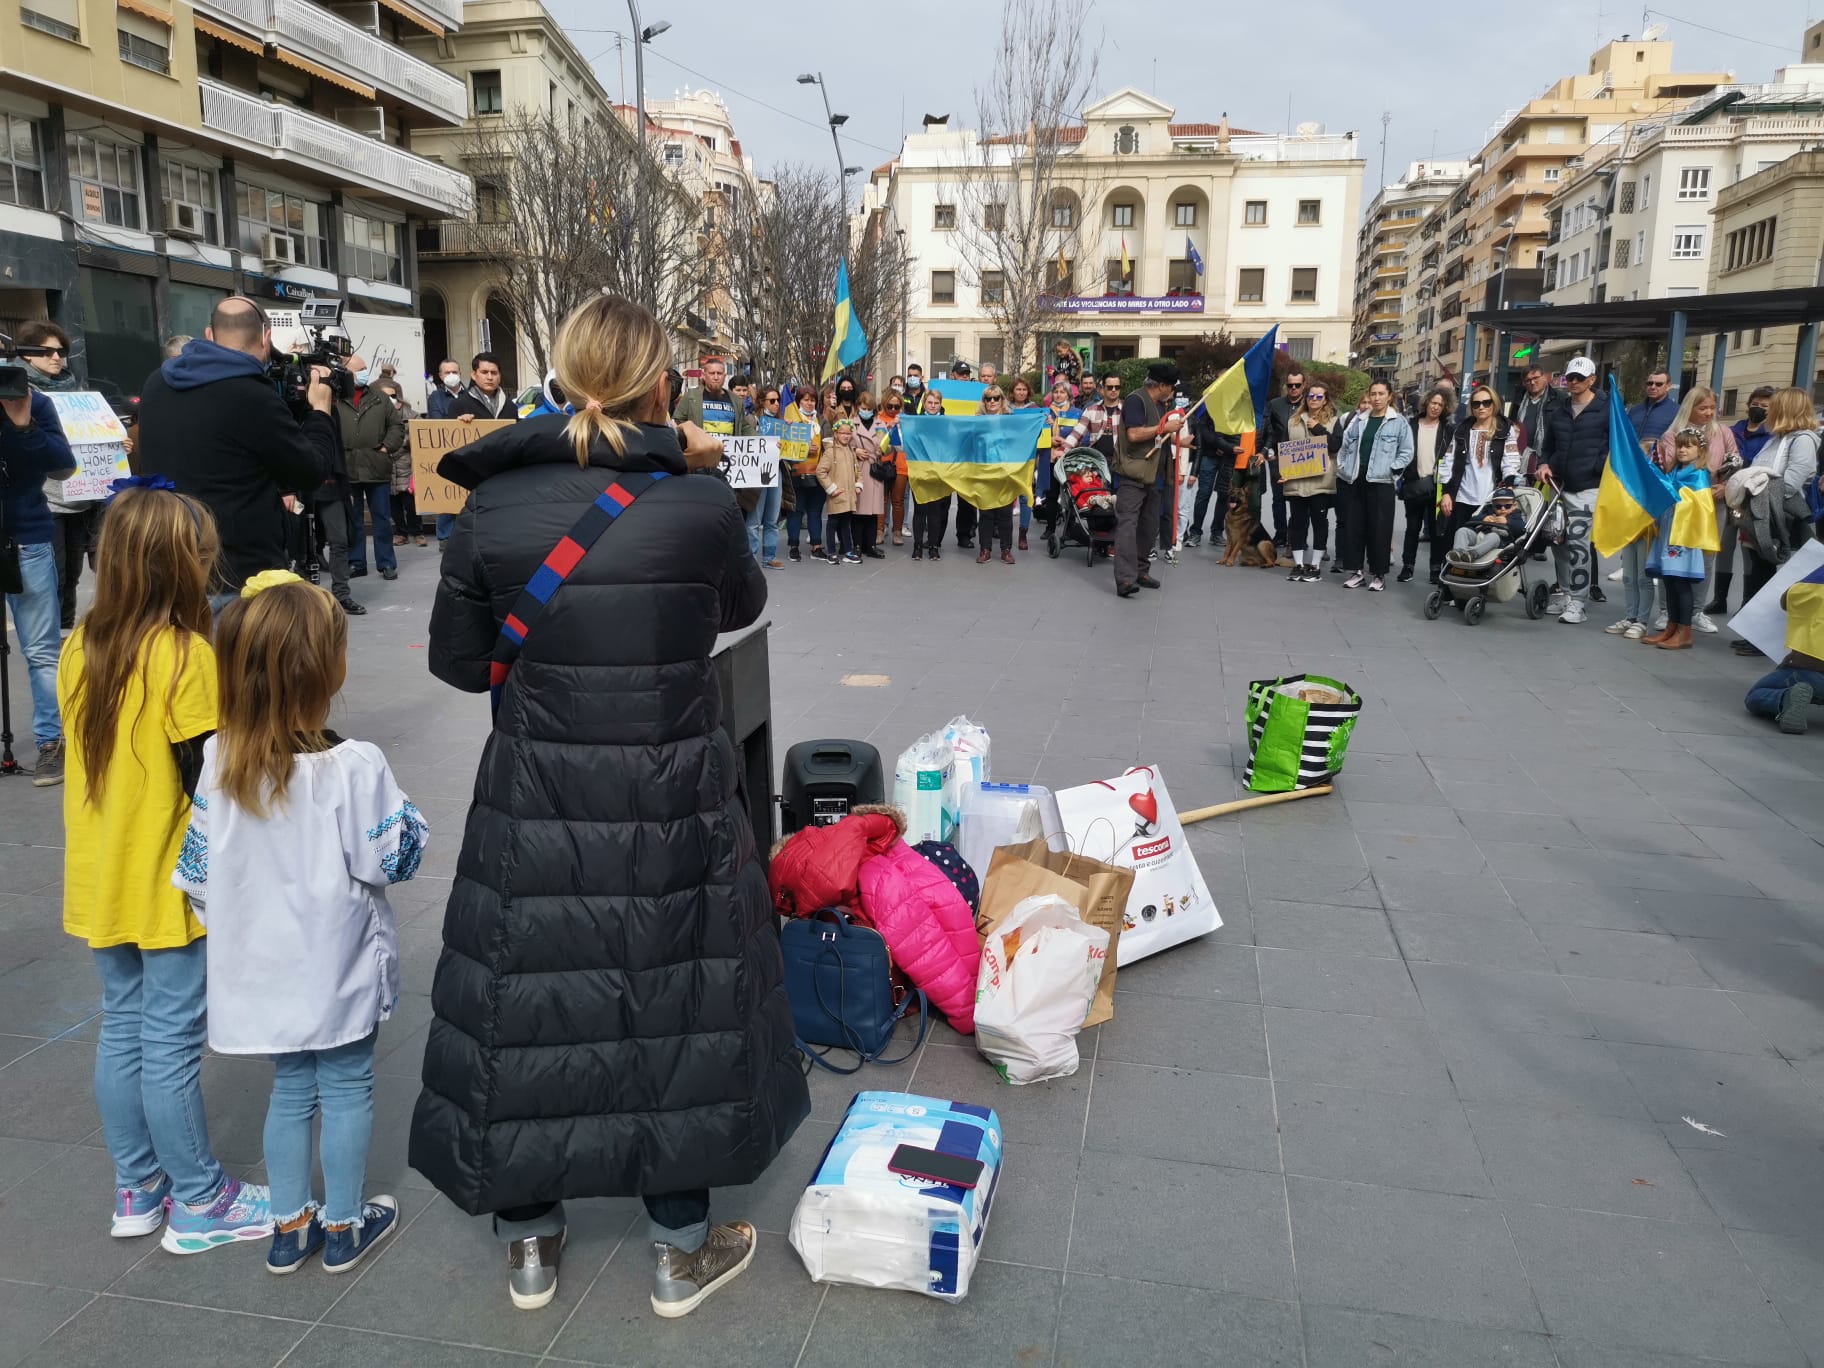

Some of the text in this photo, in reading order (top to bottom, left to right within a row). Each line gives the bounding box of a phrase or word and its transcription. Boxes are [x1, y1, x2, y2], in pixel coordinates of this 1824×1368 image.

[286, 285, 315, 299] CaixaBank
[1069, 300, 1080, 308] LAS
[1082, 300, 1117, 308] VIOLENCIAS
[1118, 300, 1128, 308] NO
[1128, 300, 1147, 308] MIRES
[1148, 300, 1153, 308] A
[1154, 300, 1172, 308] OTRO
[1172, 299, 1189, 308] LADO
[417, 427, 481, 449] EUROPA
[773, 422, 808, 441] FREE
[80, 441, 121, 454] LOST MY
[723, 438, 767, 453] ENER
[780, 442, 808, 459] AINE
[83, 455, 113, 467] HOME
[82, 468, 112, 478] TWICE
[424, 486, 435, 501] A
[1568, 504, 1593, 591] 1969
